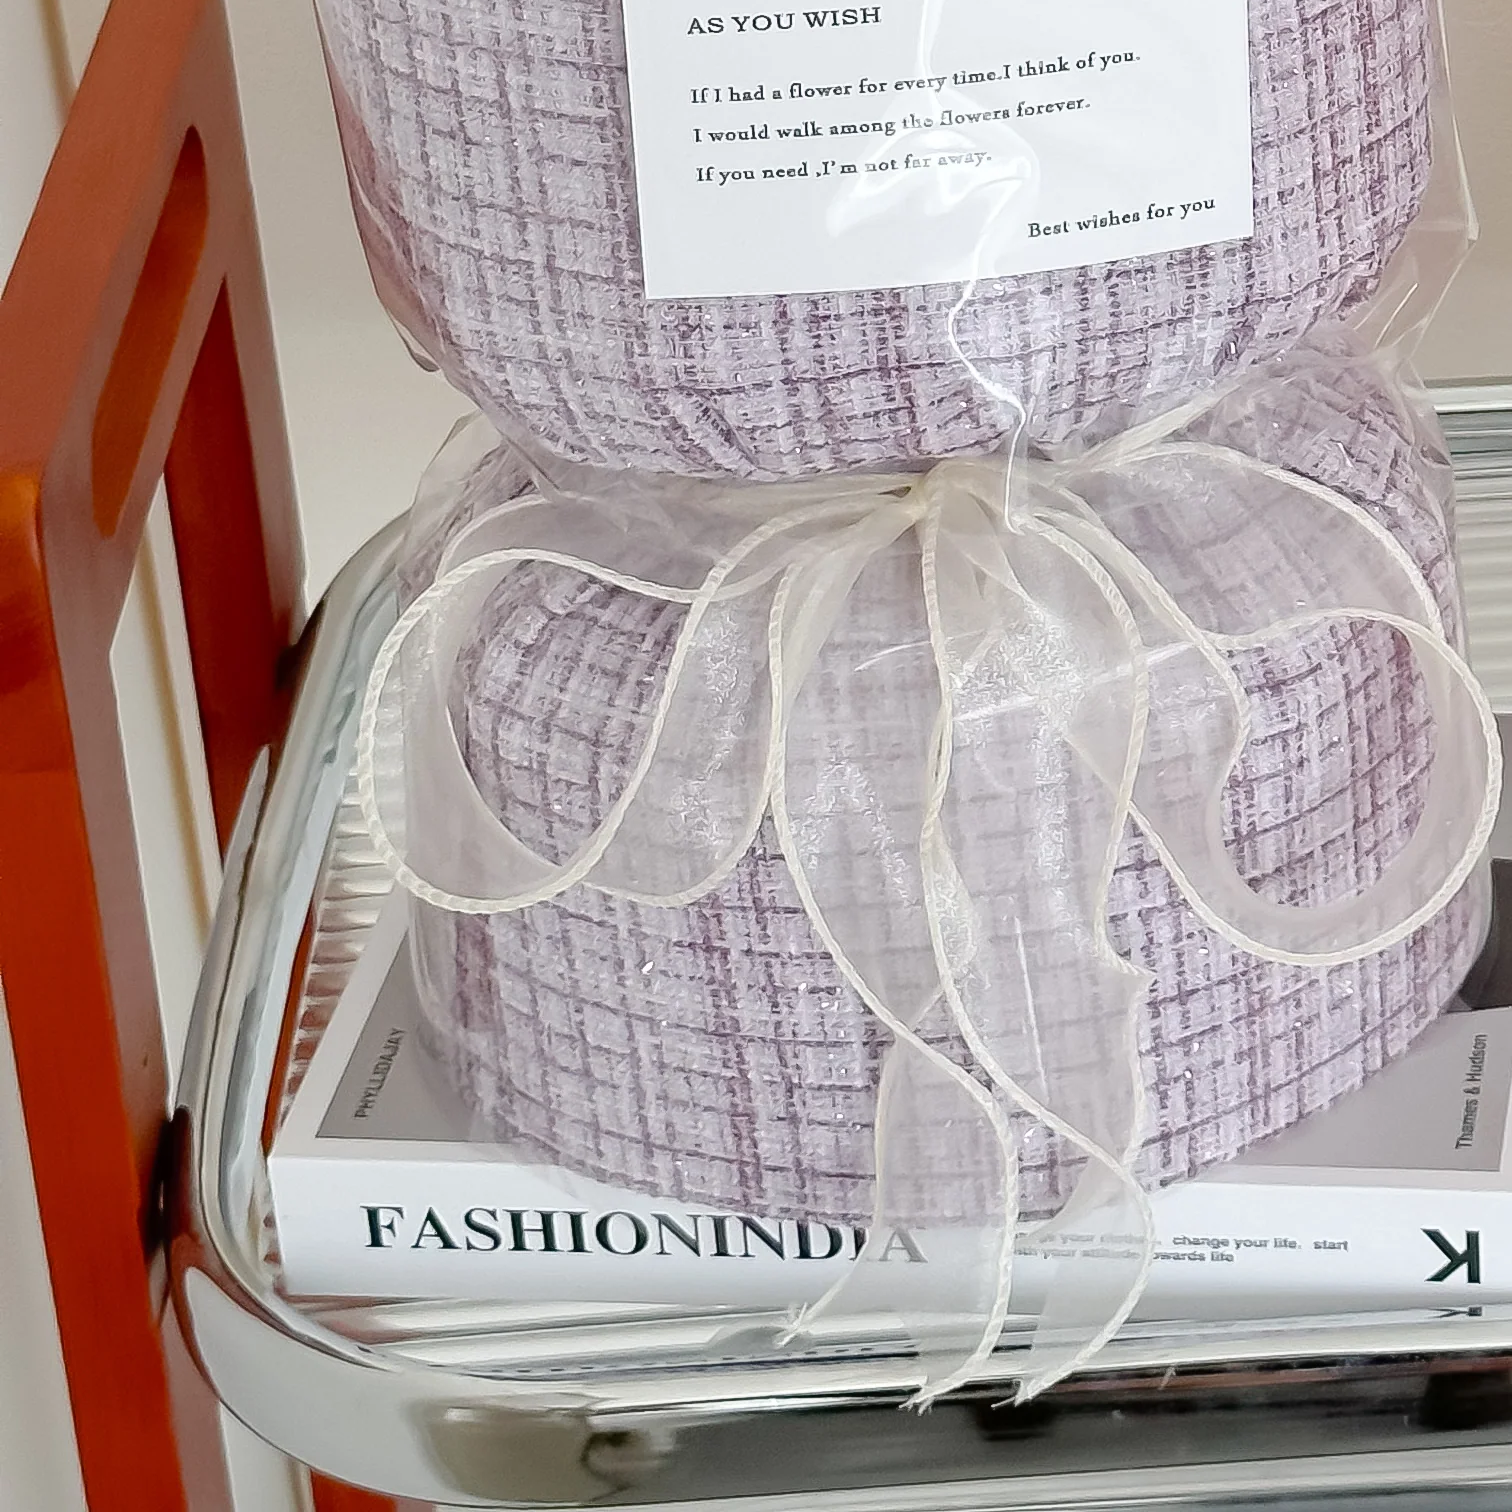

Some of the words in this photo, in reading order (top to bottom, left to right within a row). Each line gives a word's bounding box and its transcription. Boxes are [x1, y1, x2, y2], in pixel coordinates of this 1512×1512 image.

[687, 17, 725, 35] AS
[731, 13, 796, 31] YOU
[803, 6, 882, 28] WISH
[691, 88, 708, 103] If
[714, 88, 722, 102] I
[728, 85, 765, 101] had
[772, 89, 782, 99] a
[789, 82, 852, 98] flower
[858, 77, 887, 93] for
[893, 76, 947, 92] every
[1017, 56, 1070, 77] think
[1075, 51, 1096, 69] of
[1099, 50, 1141, 71] you.
[693, 128, 702, 142] I
[708, 123, 770, 142] would
[776, 120, 823, 138] walk
[829, 120, 896, 136] among
[901, 113, 934, 129] the
[940, 110, 1010, 126] flowers
[1016, 98, 1091, 118] forever.
[696, 167, 713, 182] If
[718, 168, 755, 186] you
[762, 161, 808, 179] need
[865, 159, 900, 172] not
[904, 154, 931, 170] far
[937, 152, 992, 167] away.
[1028, 222, 1070, 238] Best
[1077, 210, 1140, 231] wishes
[1146, 202, 1175, 220] for
[1180, 199, 1216, 220] you
[1465, 1033, 1488, 1081] Hudson
[1455, 1099, 1479, 1149] Thames
[1172, 1235, 1229, 1249] change
[1234, 1236, 1269, 1249] your
[1314, 1238, 1348, 1250] start
[1210, 1251, 1234, 1262] life
